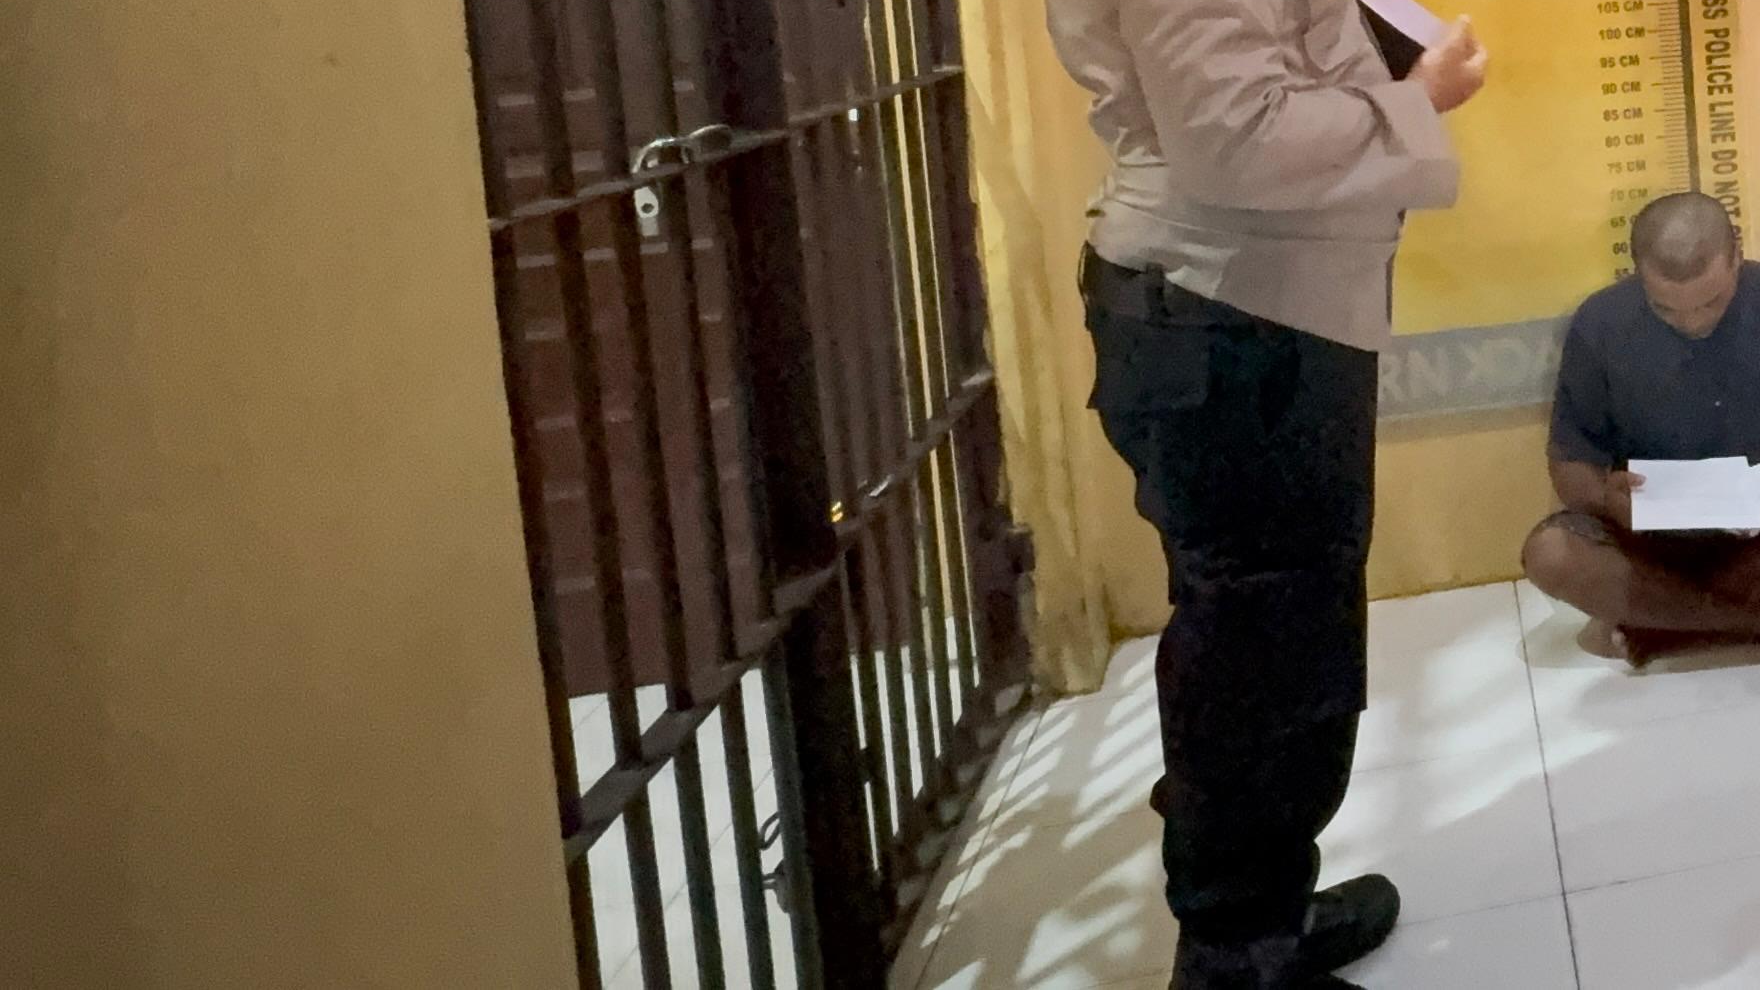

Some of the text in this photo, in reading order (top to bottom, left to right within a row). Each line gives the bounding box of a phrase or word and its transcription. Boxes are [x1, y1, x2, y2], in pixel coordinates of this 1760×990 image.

[1624, 0, 1644, 12] CM
[1626, 26, 1646, 38] CM
[1619, 55, 1640, 67] CM
[1704, 27, 1734, 96] POLICE
[1621, 81, 1642, 93] CM
[1623, 107, 1643, 119] CM
[1708, 101, 1736, 144] LINE
[1624, 133, 1645, 146] CM
[1627, 160, 1647, 172] CM
[1711, 149, 1738, 175] DO
[1628, 188, 1648, 200] CM
[1378, 347, 1449, 402] RN
